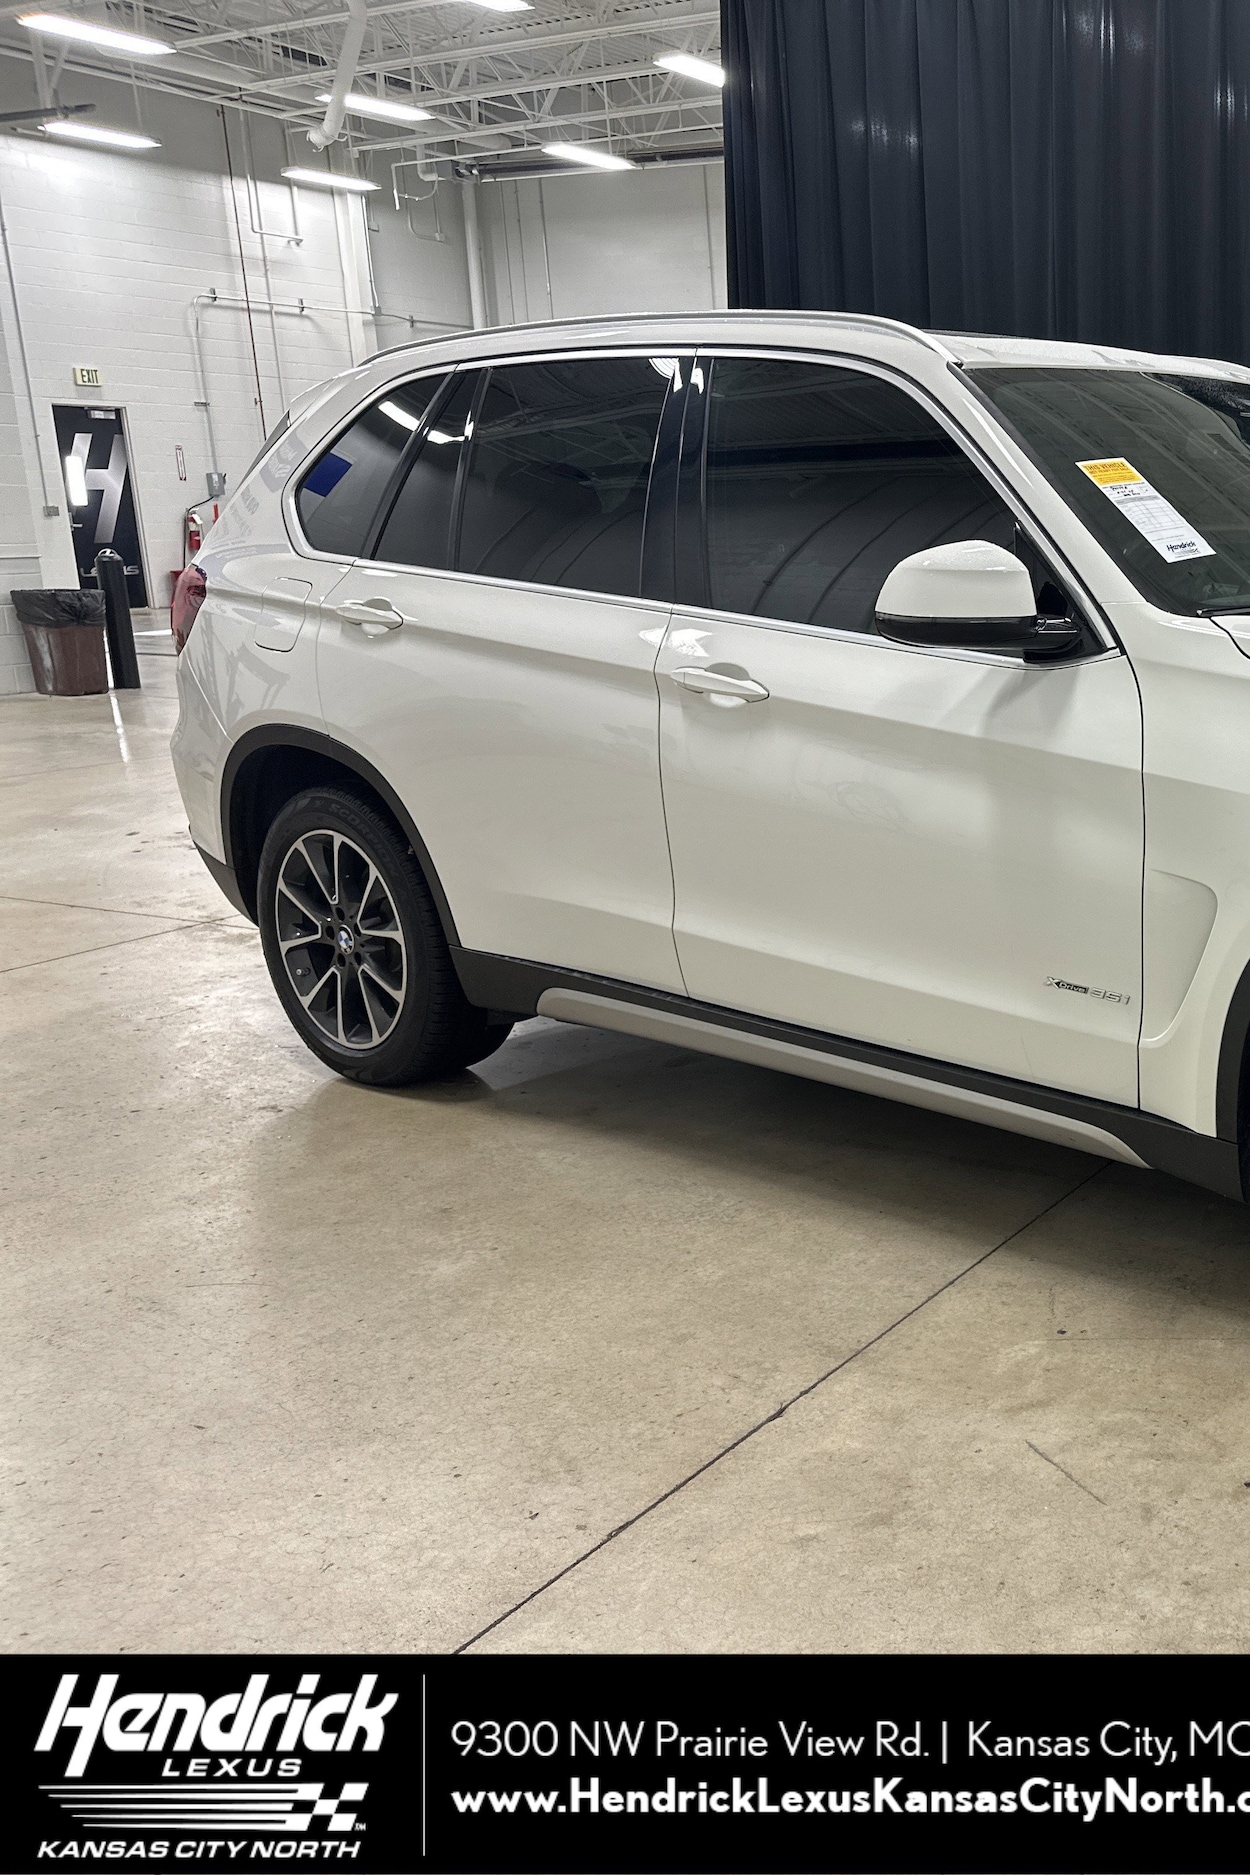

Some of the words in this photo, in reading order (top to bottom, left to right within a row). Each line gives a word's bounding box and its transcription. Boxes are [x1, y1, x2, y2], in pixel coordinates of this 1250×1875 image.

[80, 368, 99, 384] EXIT
[1100, 461, 1127, 470] VEHICLE
[1166, 541, 1197, 553] Hendrick
